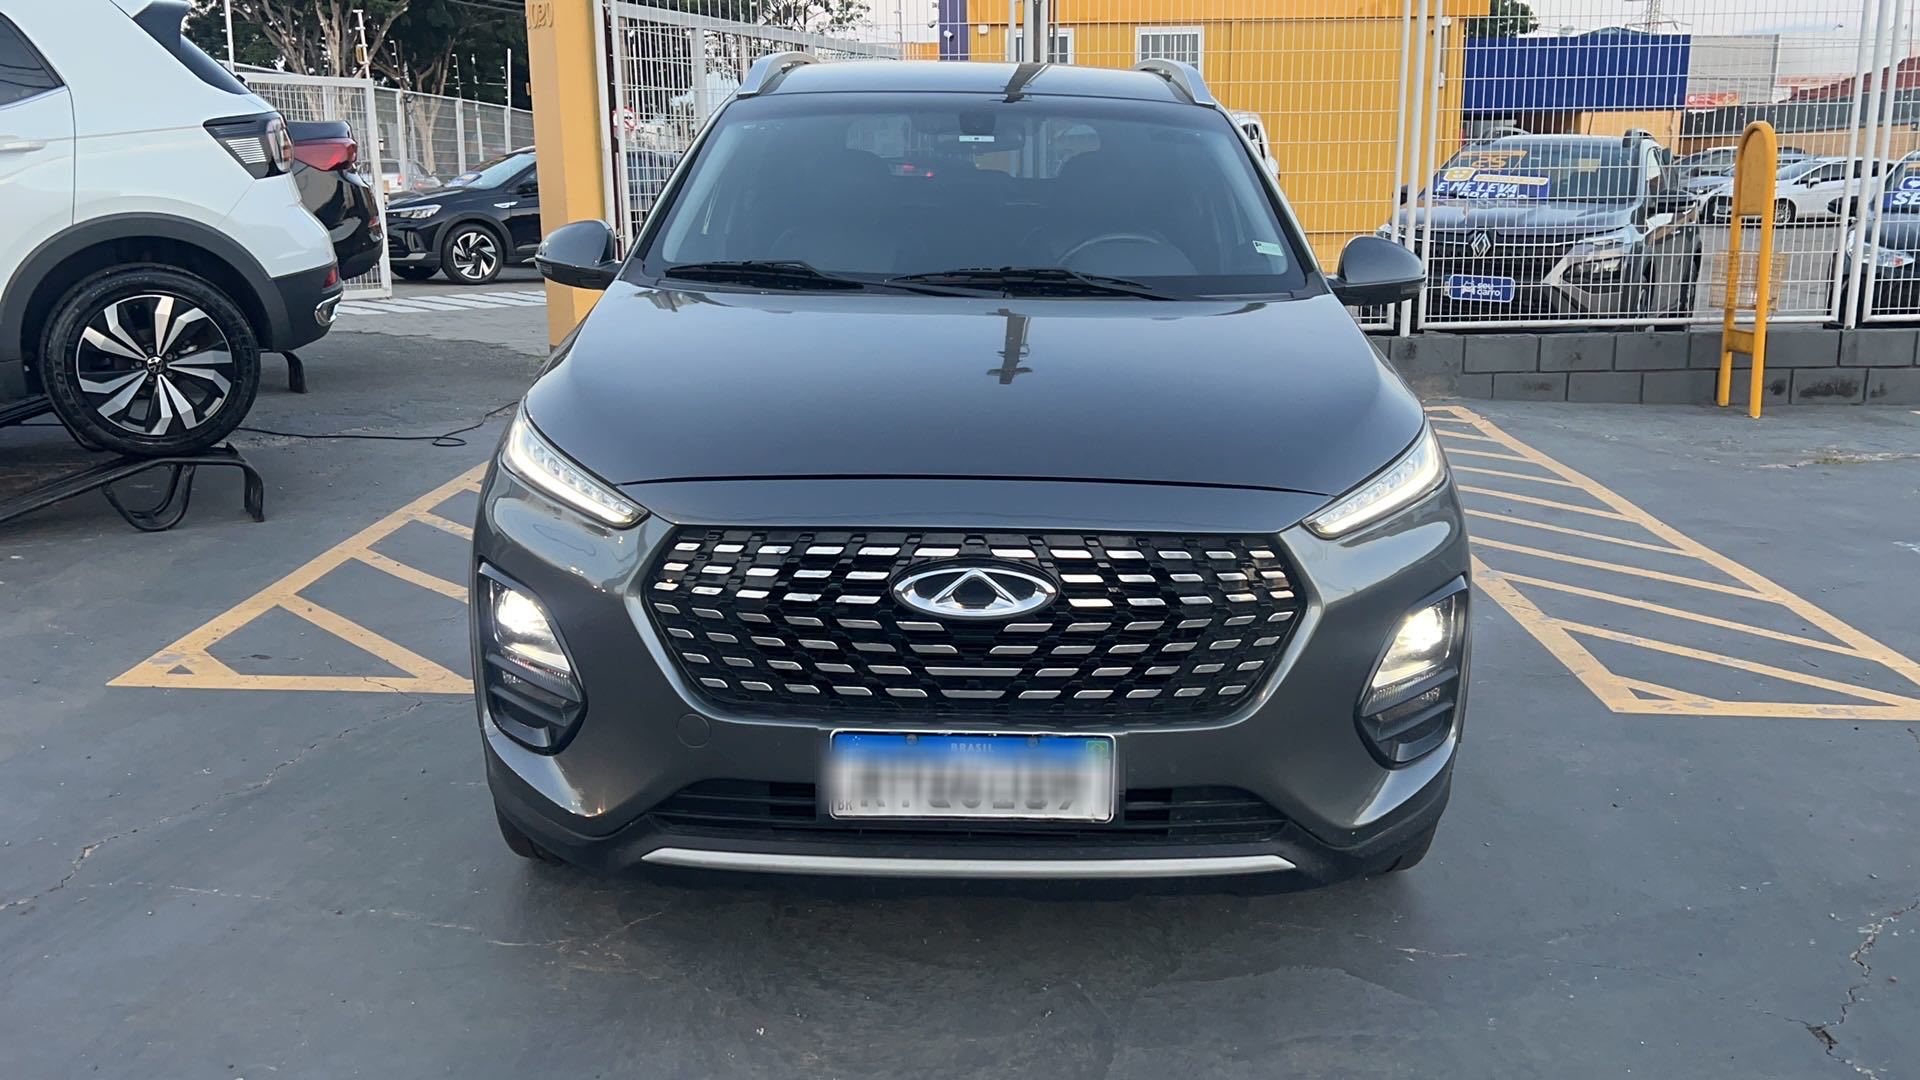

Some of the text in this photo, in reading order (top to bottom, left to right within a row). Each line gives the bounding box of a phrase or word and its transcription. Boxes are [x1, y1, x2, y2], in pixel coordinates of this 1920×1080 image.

[1450, 182, 1475, 192] ME
[1477, 182, 1519, 194] LEVA
[1477, 289, 1501, 297] carro
[950, 742, 993, 753] BRASIL
